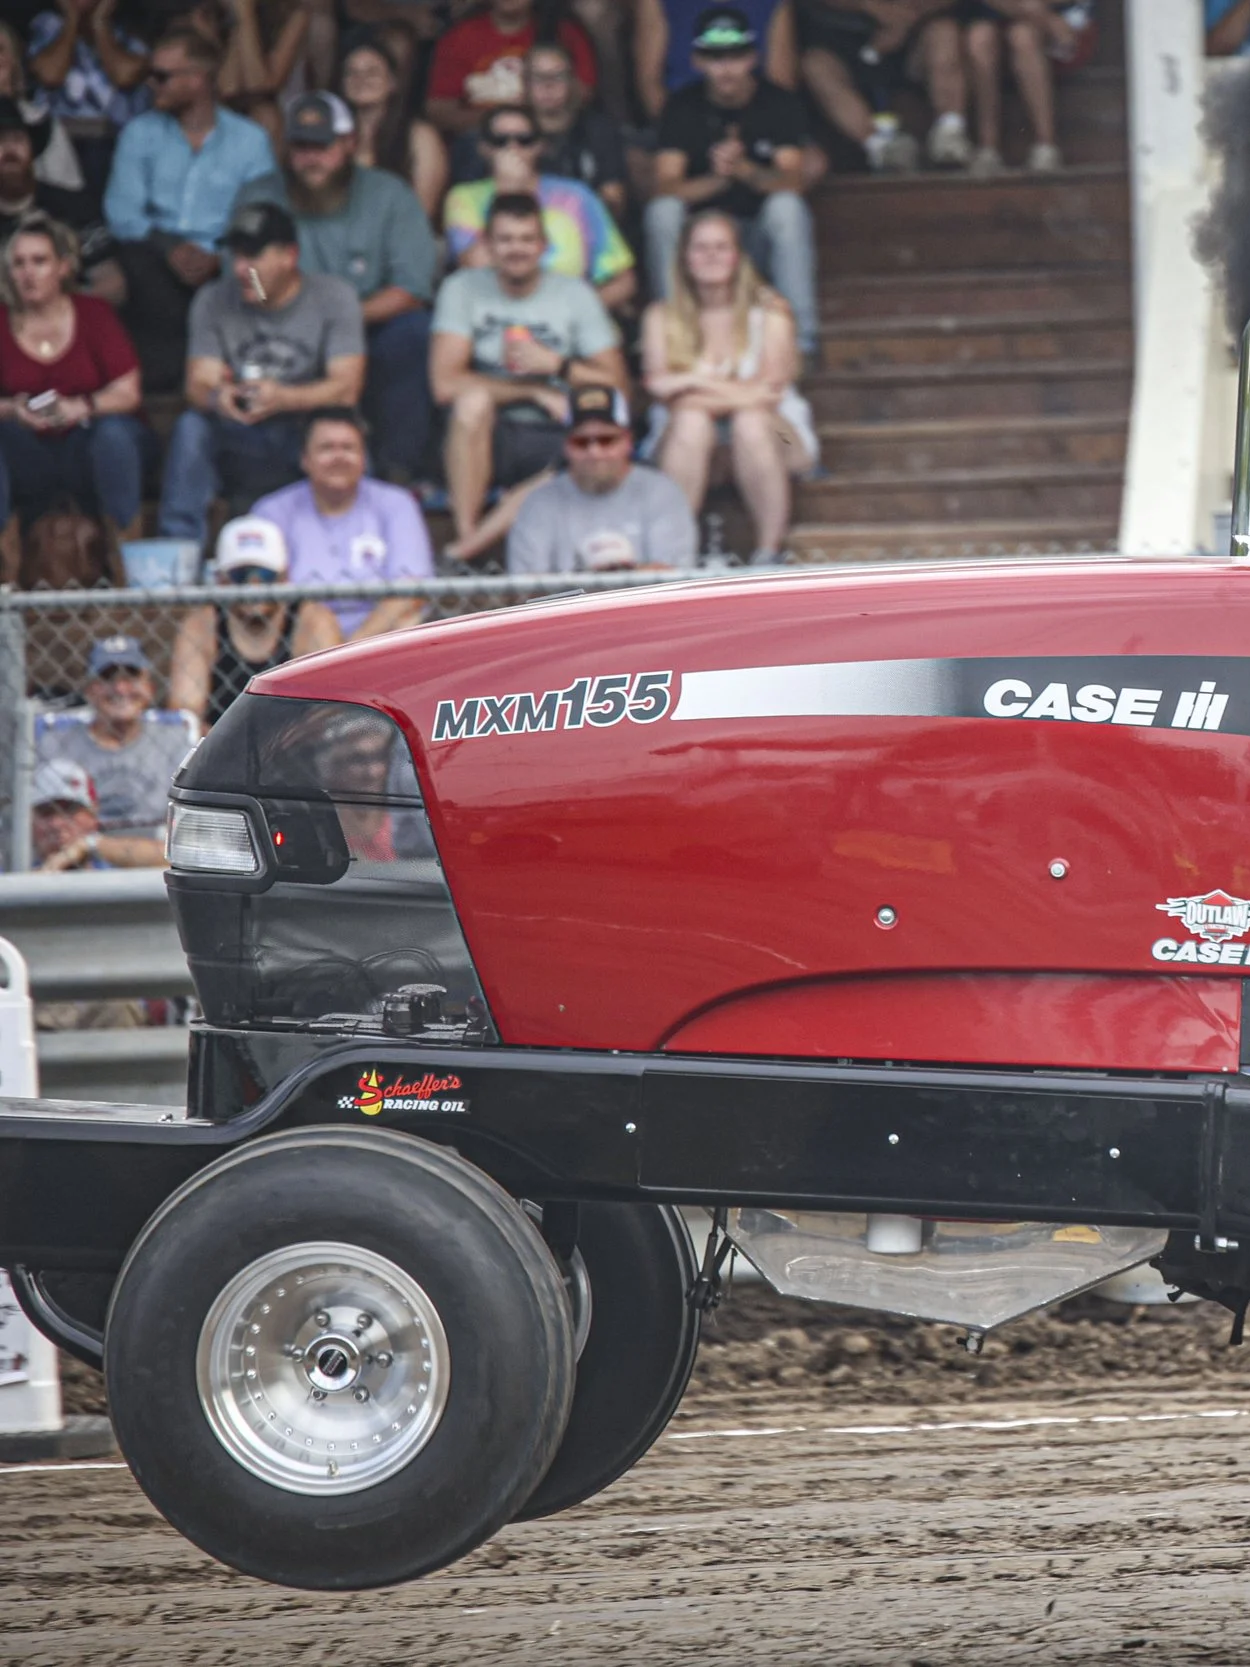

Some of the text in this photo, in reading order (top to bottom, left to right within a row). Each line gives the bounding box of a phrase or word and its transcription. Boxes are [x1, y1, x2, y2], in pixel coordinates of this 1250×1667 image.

[431, 670, 673, 742] MXM155
[983, 678, 1163, 726] CASE
[1186, 900, 1249, 929] OUTLAW
[1152, 938, 1245, 965] CASE
[354, 1073, 462, 1106] Schaeffer's
[384, 1098, 466, 1112] RACING OIL
